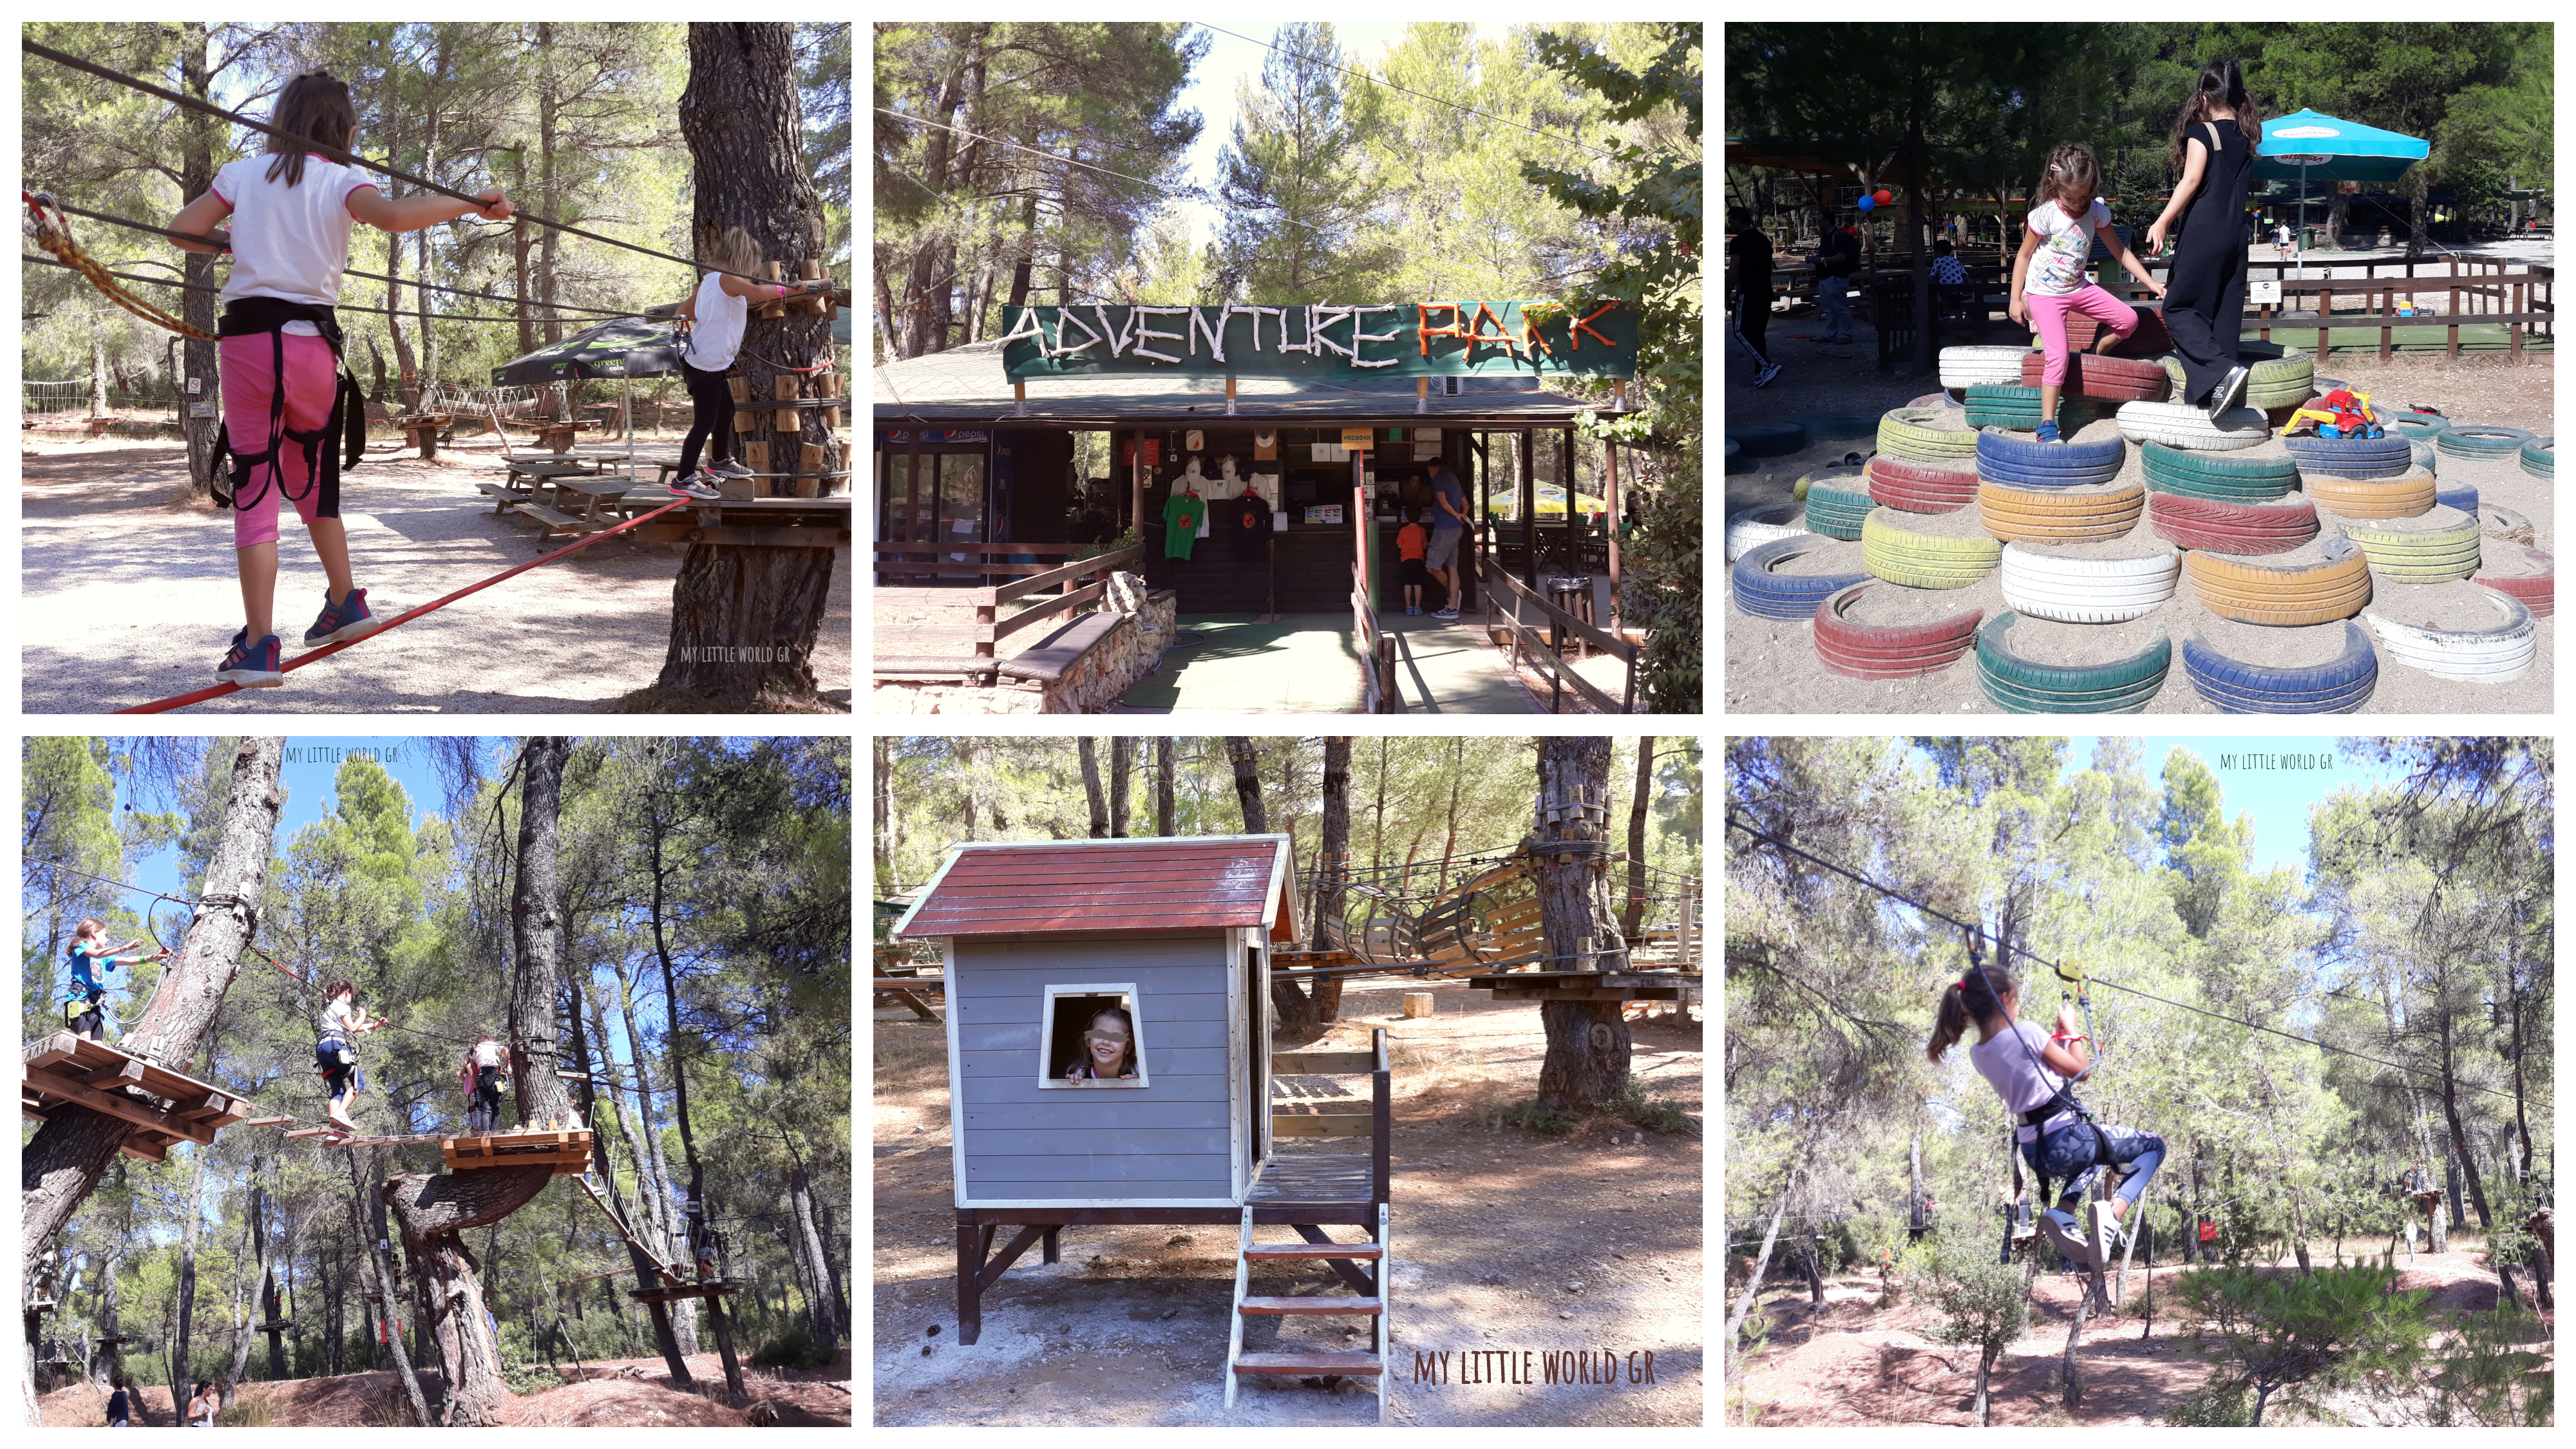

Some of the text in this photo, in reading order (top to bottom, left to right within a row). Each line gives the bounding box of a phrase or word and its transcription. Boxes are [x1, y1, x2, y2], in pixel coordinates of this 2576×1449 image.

[988, 298, 1620, 368] ADVENTURE PARK
[591, 357, 625, 369] green
[958, 430, 984, 438] pepsi
[1001, 447, 1012, 456] pepsi
